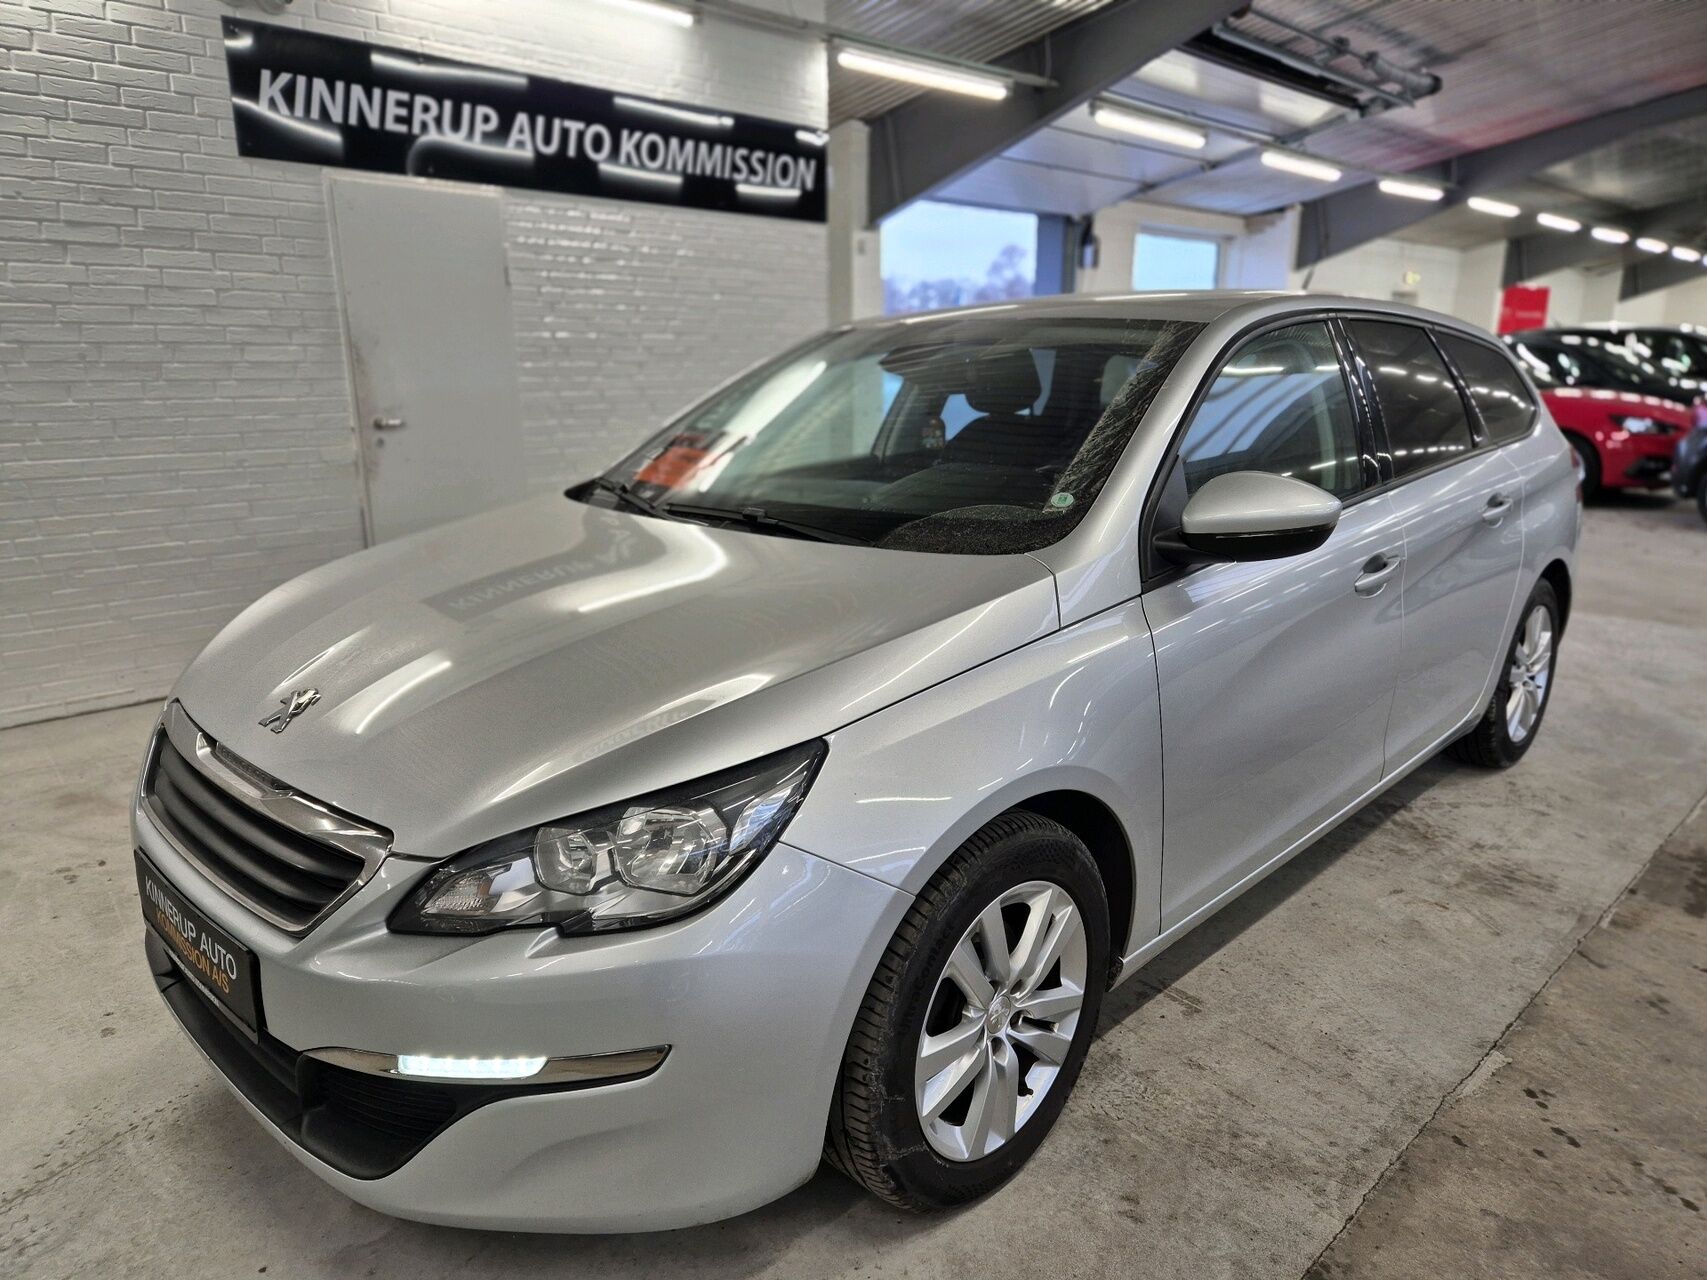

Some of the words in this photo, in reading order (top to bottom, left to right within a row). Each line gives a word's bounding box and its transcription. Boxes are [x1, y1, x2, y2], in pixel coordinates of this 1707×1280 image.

[259, 69, 499, 145] KINNERUP
[507, 112, 612, 162] AUTO
[619, 130, 817, 192] KOMMISSION
[145, 876, 197, 943] KINNERUP
[200, 932, 237, 980] AUTO
[156, 911, 211, 977] KOMMISSION
[212, 965, 230, 994] A/S
